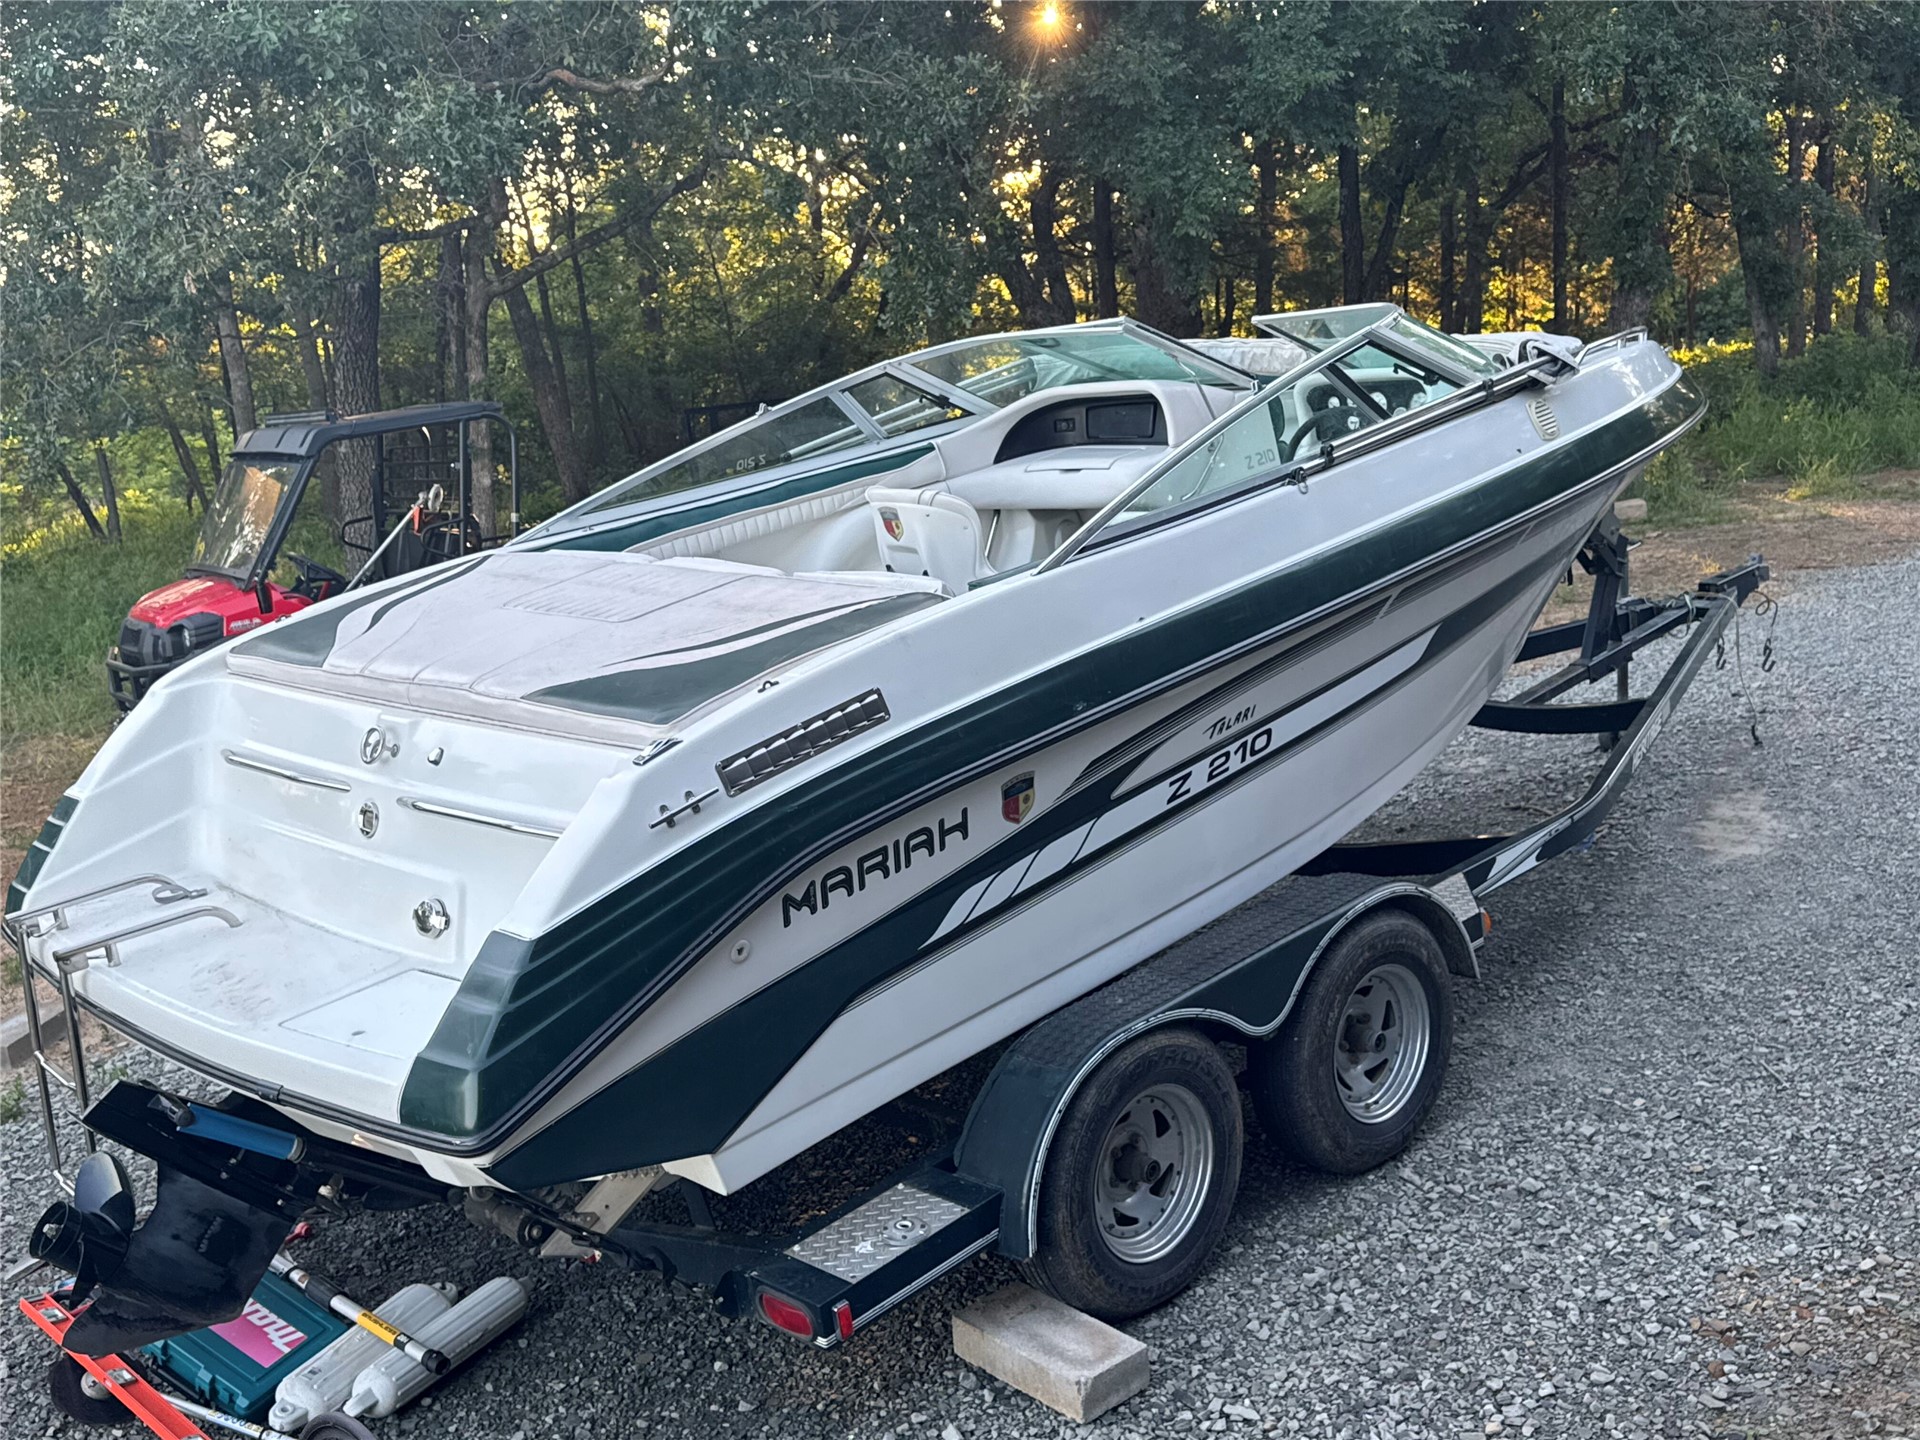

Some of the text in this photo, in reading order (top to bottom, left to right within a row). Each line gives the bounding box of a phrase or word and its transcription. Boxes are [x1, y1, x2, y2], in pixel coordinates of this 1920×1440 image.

[1244, 448, 1276, 470] Z 210
[1202, 704, 1257, 740] TALARI
[1166, 727, 1272, 805] Z 210
[782, 807, 969, 928] MARIAH
